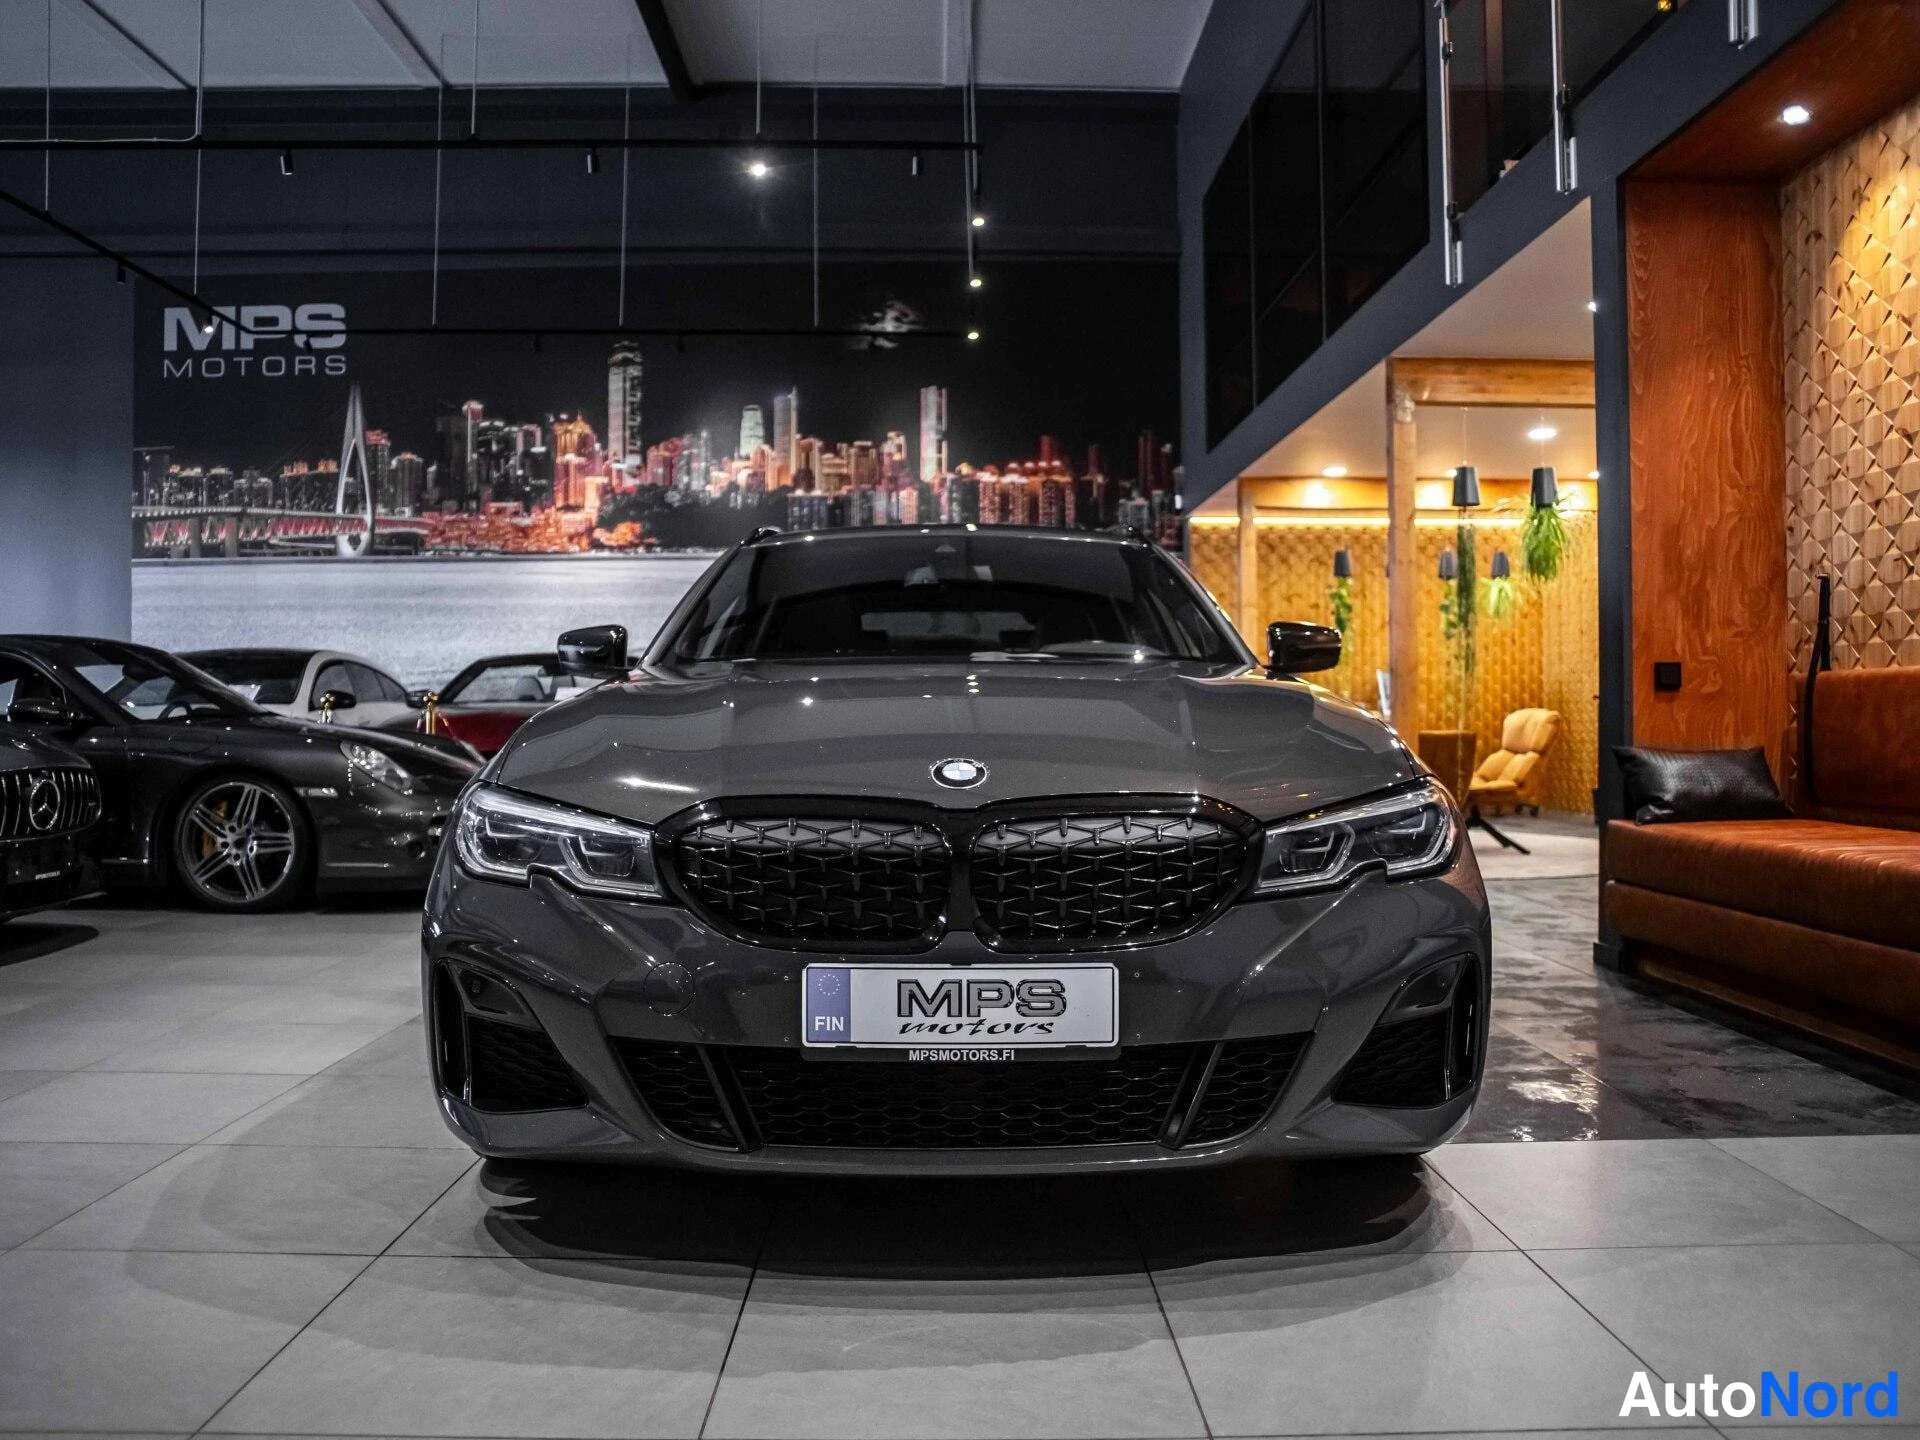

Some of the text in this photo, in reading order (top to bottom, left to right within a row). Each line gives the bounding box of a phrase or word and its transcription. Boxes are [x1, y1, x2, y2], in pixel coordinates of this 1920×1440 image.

[163, 303, 347, 351] MPS
[163, 355, 347, 379] MOTORS
[897, 979, 1067, 1018] MPS
[814, 1016, 845, 1032] FIN
[899, 1018, 1054, 1035] motors
[908, 1049, 1015, 1062] MPSMOTORS.FI
